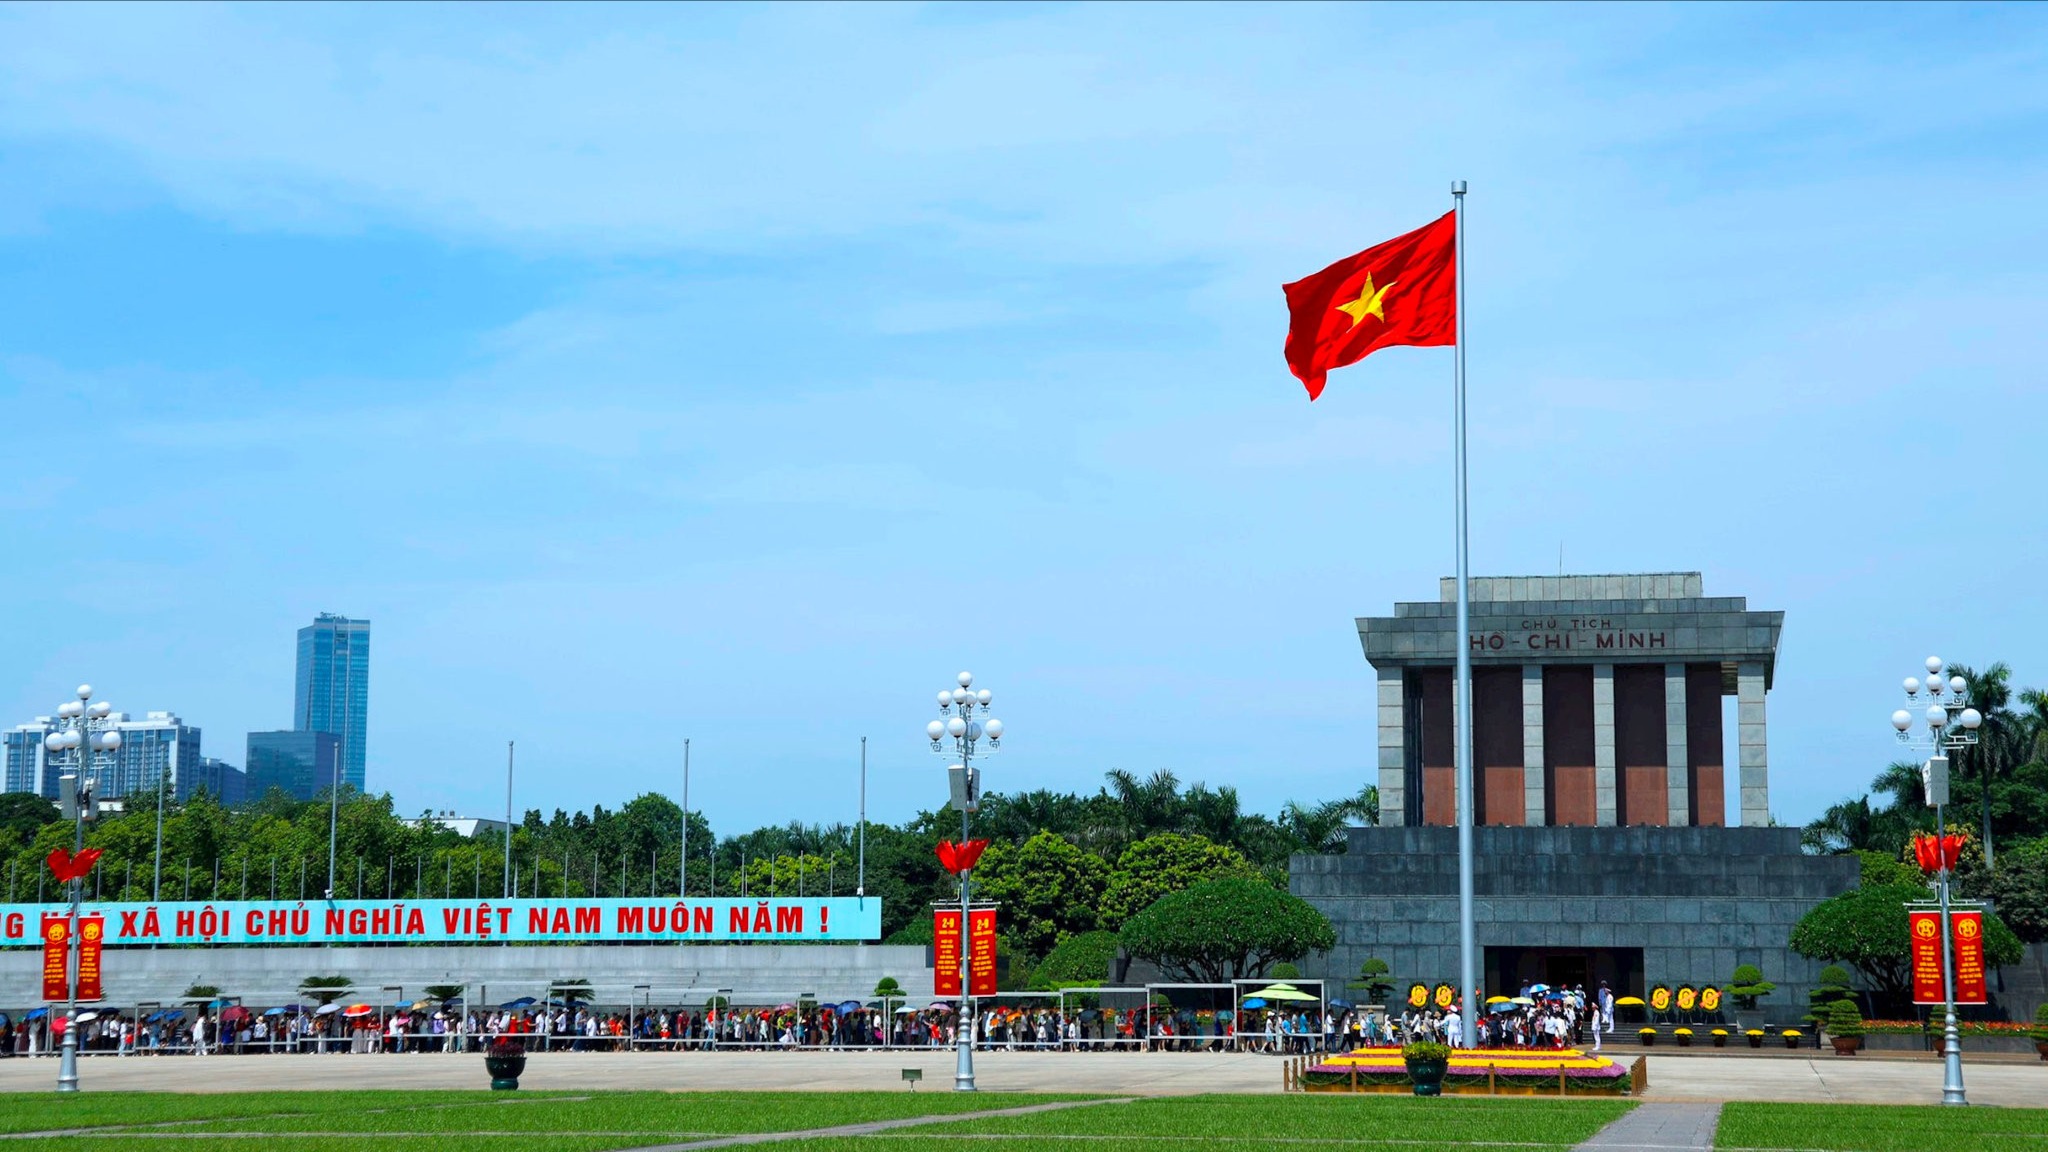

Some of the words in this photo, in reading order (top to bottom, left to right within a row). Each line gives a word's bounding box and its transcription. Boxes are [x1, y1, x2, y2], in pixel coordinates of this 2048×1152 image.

[118, 906, 161, 937] XÃ
[175, 904, 230, 941] HỘI
[245, 901, 310, 936] CHỦ
[325, 903, 425, 935] NGHĨA
[442, 902, 513, 939] VIỆT
[528, 907, 601, 934] NAM
[616, 901, 713, 933] MUÔN
[729, 900, 803, 933] NĂM
